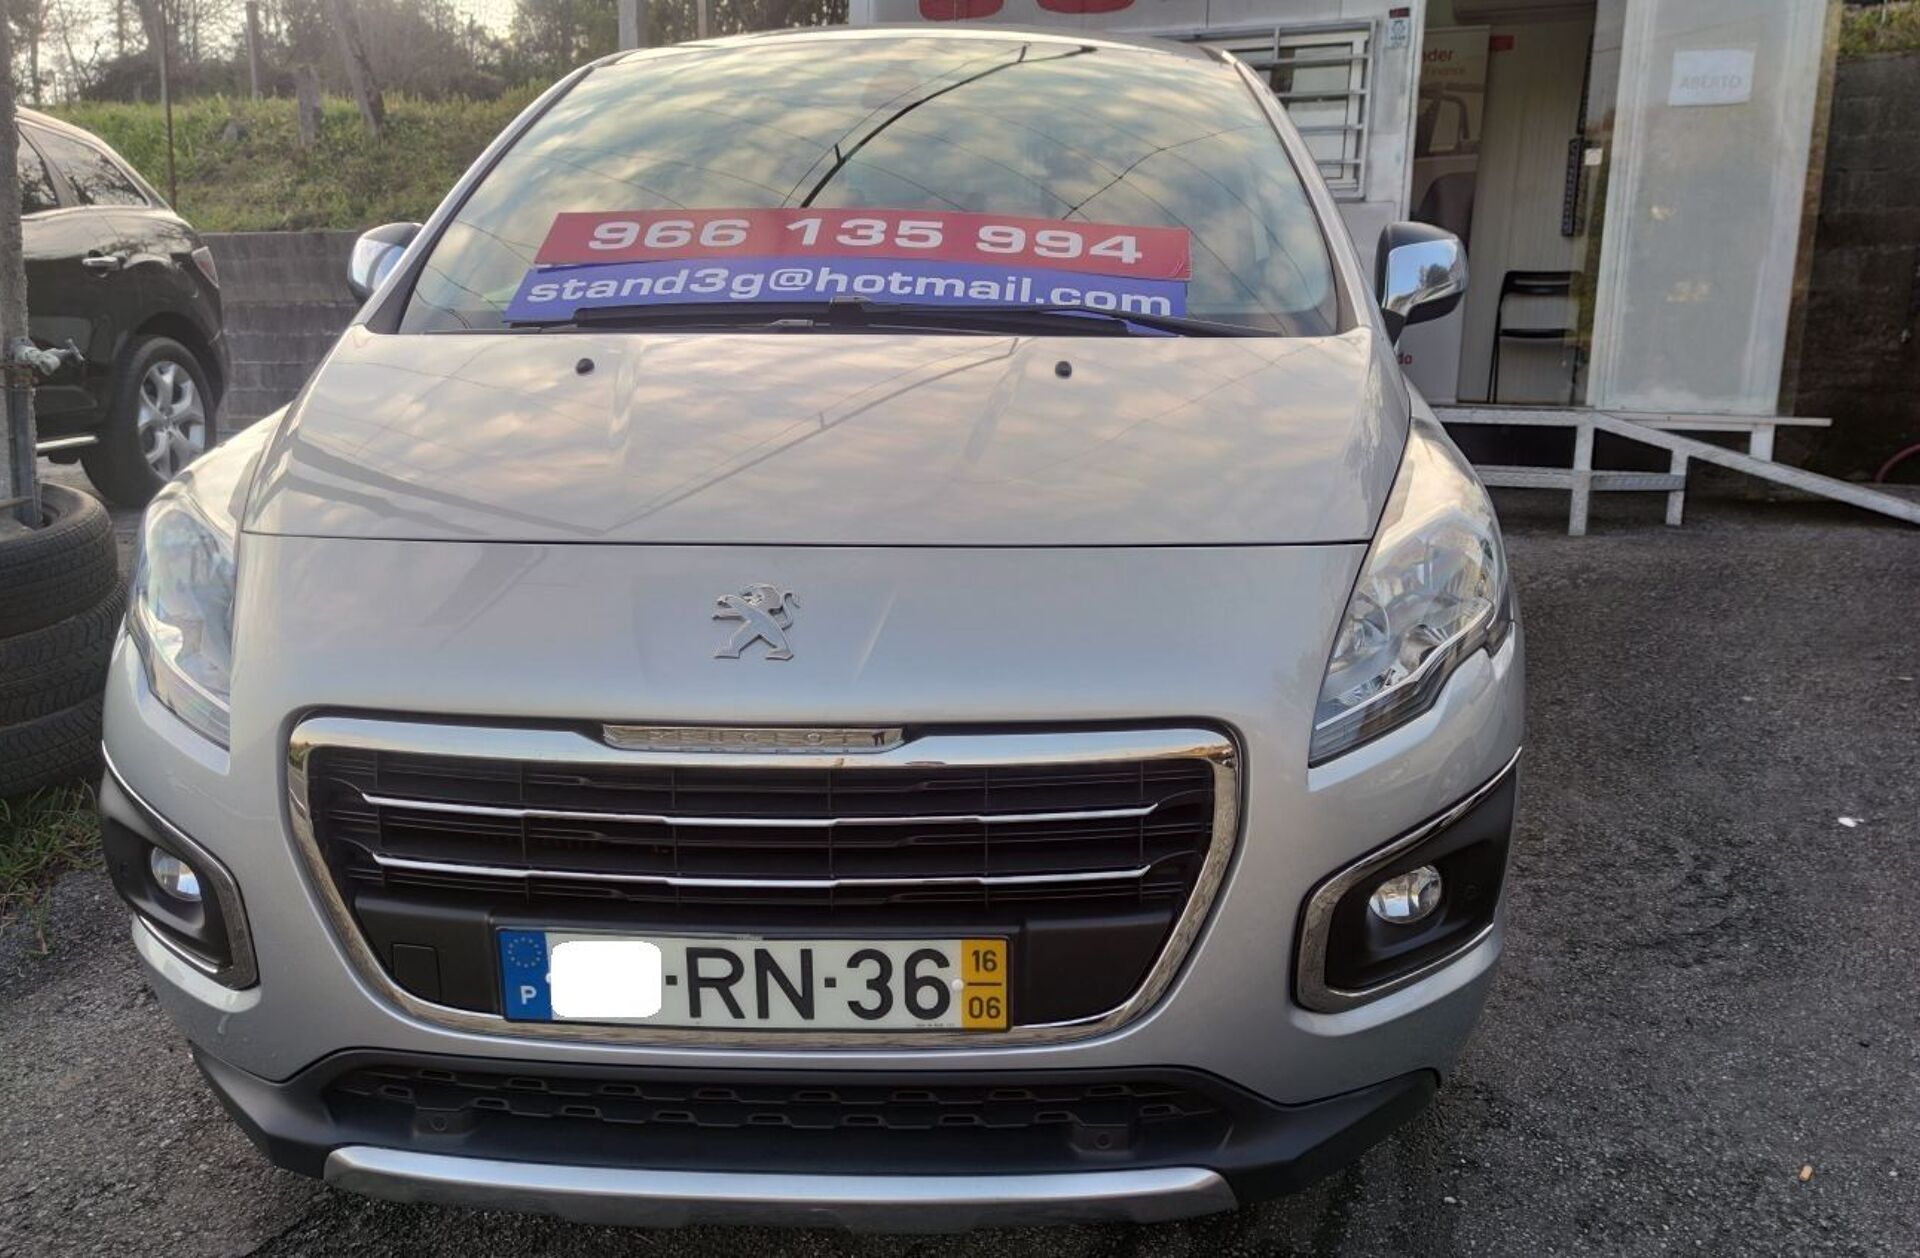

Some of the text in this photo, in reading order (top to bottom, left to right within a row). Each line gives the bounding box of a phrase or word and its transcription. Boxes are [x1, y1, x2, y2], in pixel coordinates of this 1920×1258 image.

[588, 218, 1143, 264] 966 135 994
[527, 267, 1171, 317] stand3g@hotmail.com
[972, 950, 997, 973] 16
[520, 985, 537, 1005] P
[969, 996, 1001, 1020] 06
